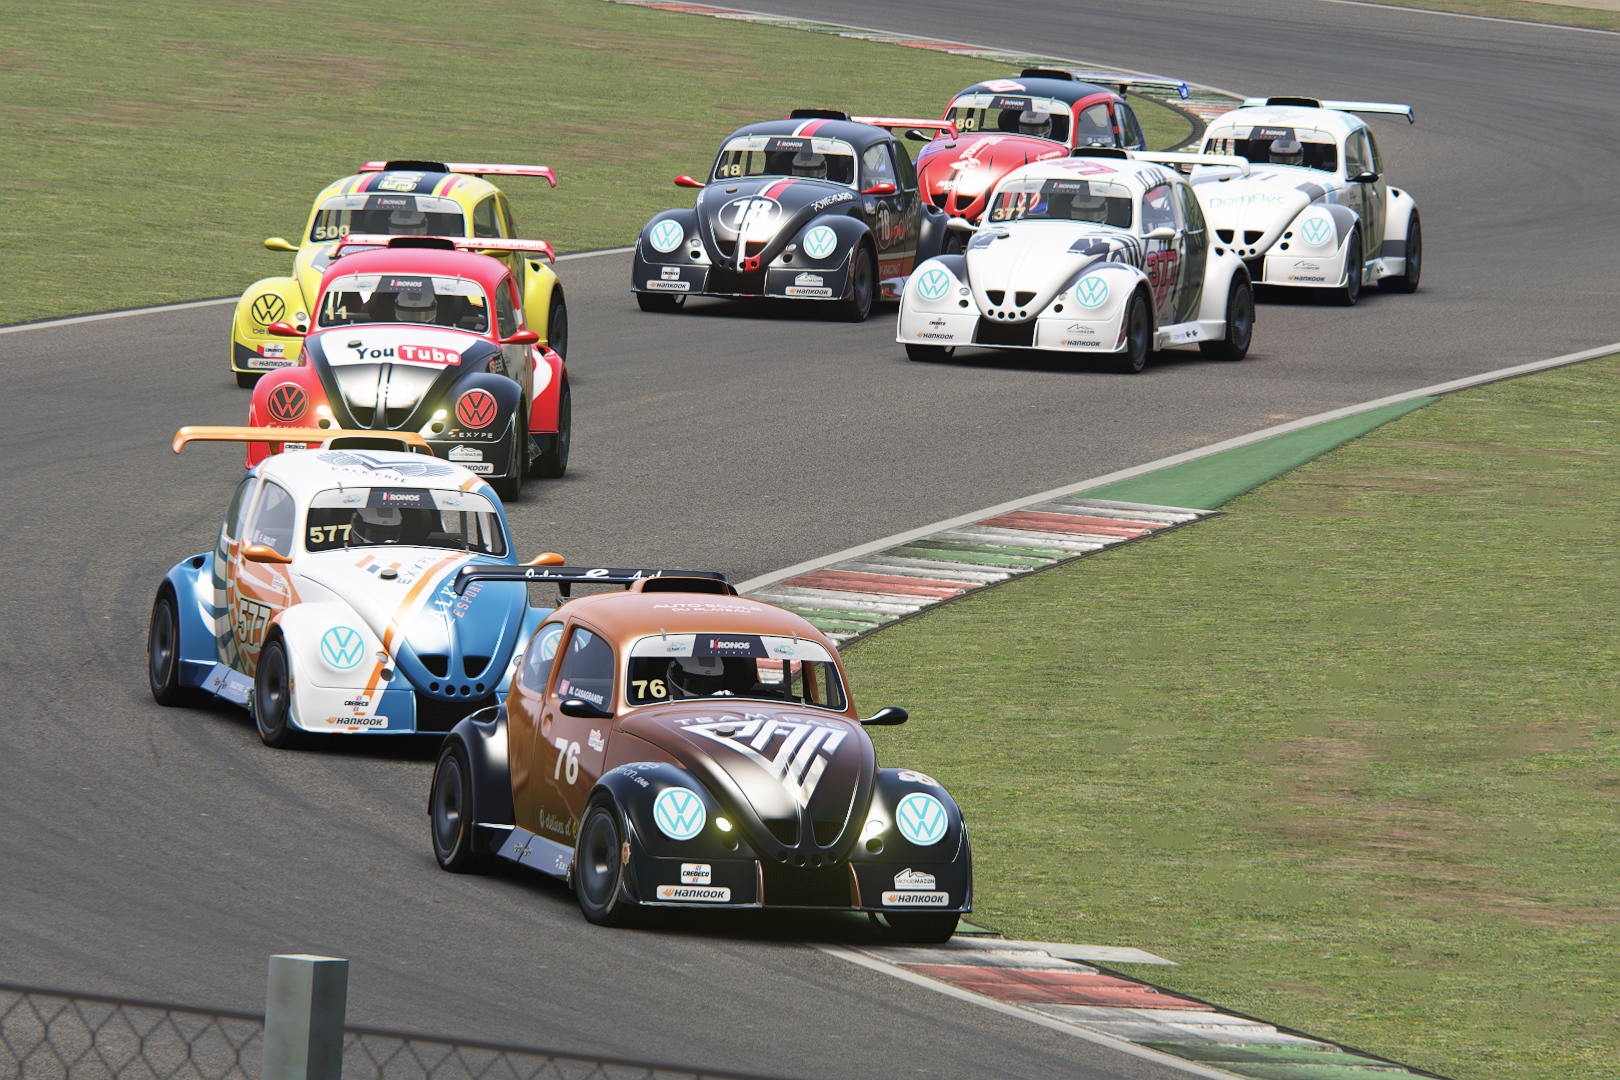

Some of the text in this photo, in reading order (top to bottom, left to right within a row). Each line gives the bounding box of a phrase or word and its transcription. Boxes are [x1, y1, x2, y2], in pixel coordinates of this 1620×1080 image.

[720, 164, 741, 177] 18
[1209, 193, 1287, 209] DomElec
[993, 207, 1026, 221] 377
[315, 225, 351, 240] 500
[878, 209, 890, 241] 18
[1147, 249, 1178, 288] 377
[390, 278, 423, 287] KRONOS
[355, 345, 460, 364] You Tube
[458, 431, 494, 439] EXYPE
[331, 466, 408, 484] VALKYRIE
[383, 490, 420, 502] KRONOS
[309, 523, 353, 544] 577
[453, 580, 485, 619] ESPORT
[653, 603, 763, 612] AUTO-ECOLE
[237, 597, 273, 648] 577
[710, 638, 751, 650] KRONOS
[574, 687, 604, 705] CASAGRANDE
[632, 678, 667, 699] 76
[674, 713, 769, 726] TEAM
[554, 736, 581, 786] 76
